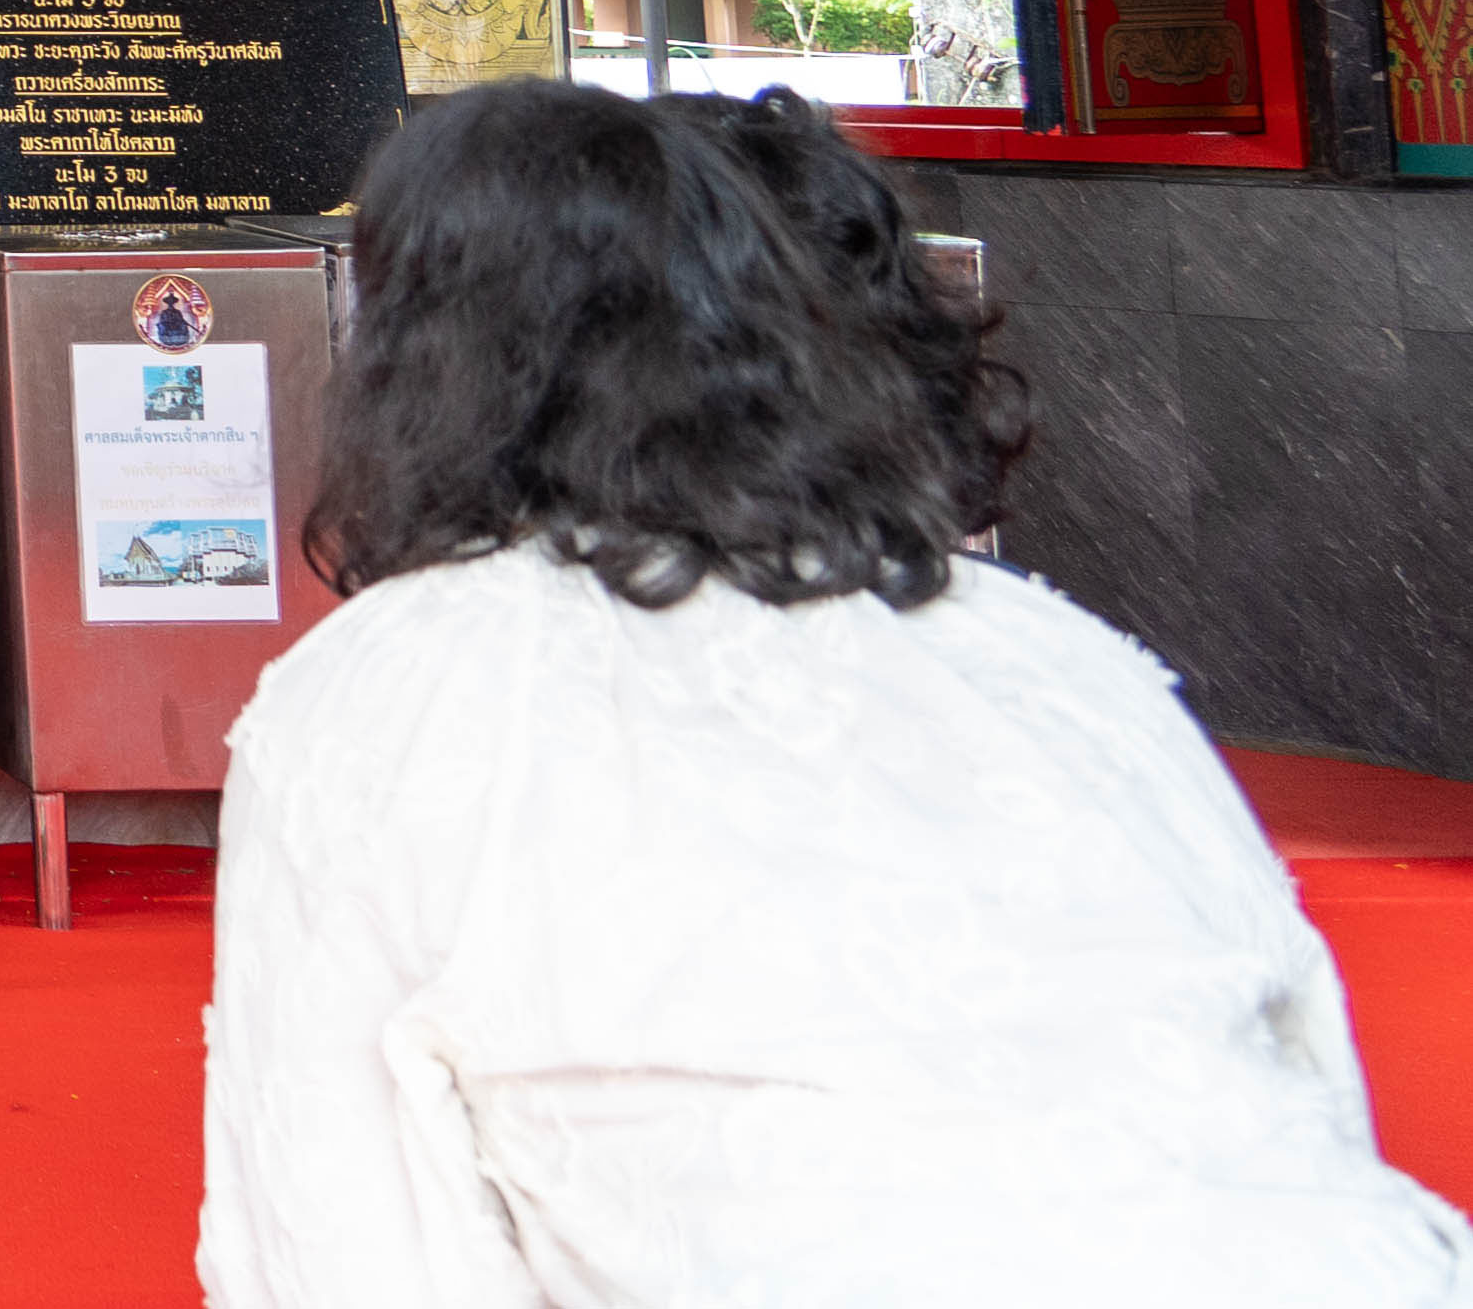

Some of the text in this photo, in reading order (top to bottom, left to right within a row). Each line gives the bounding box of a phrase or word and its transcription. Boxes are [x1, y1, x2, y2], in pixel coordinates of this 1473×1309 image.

[14, 69, 165, 91] ถวายเครื่องสักการะ
[54, 108, 123, 123] ราชาเทวะ
[20, 127, 175, 151] พระคาถาให้โชคลาภ
[55, 159, 148, 183] นะโม 3 จบ
[8, 187, 89, 211] มะหาลาโภ
